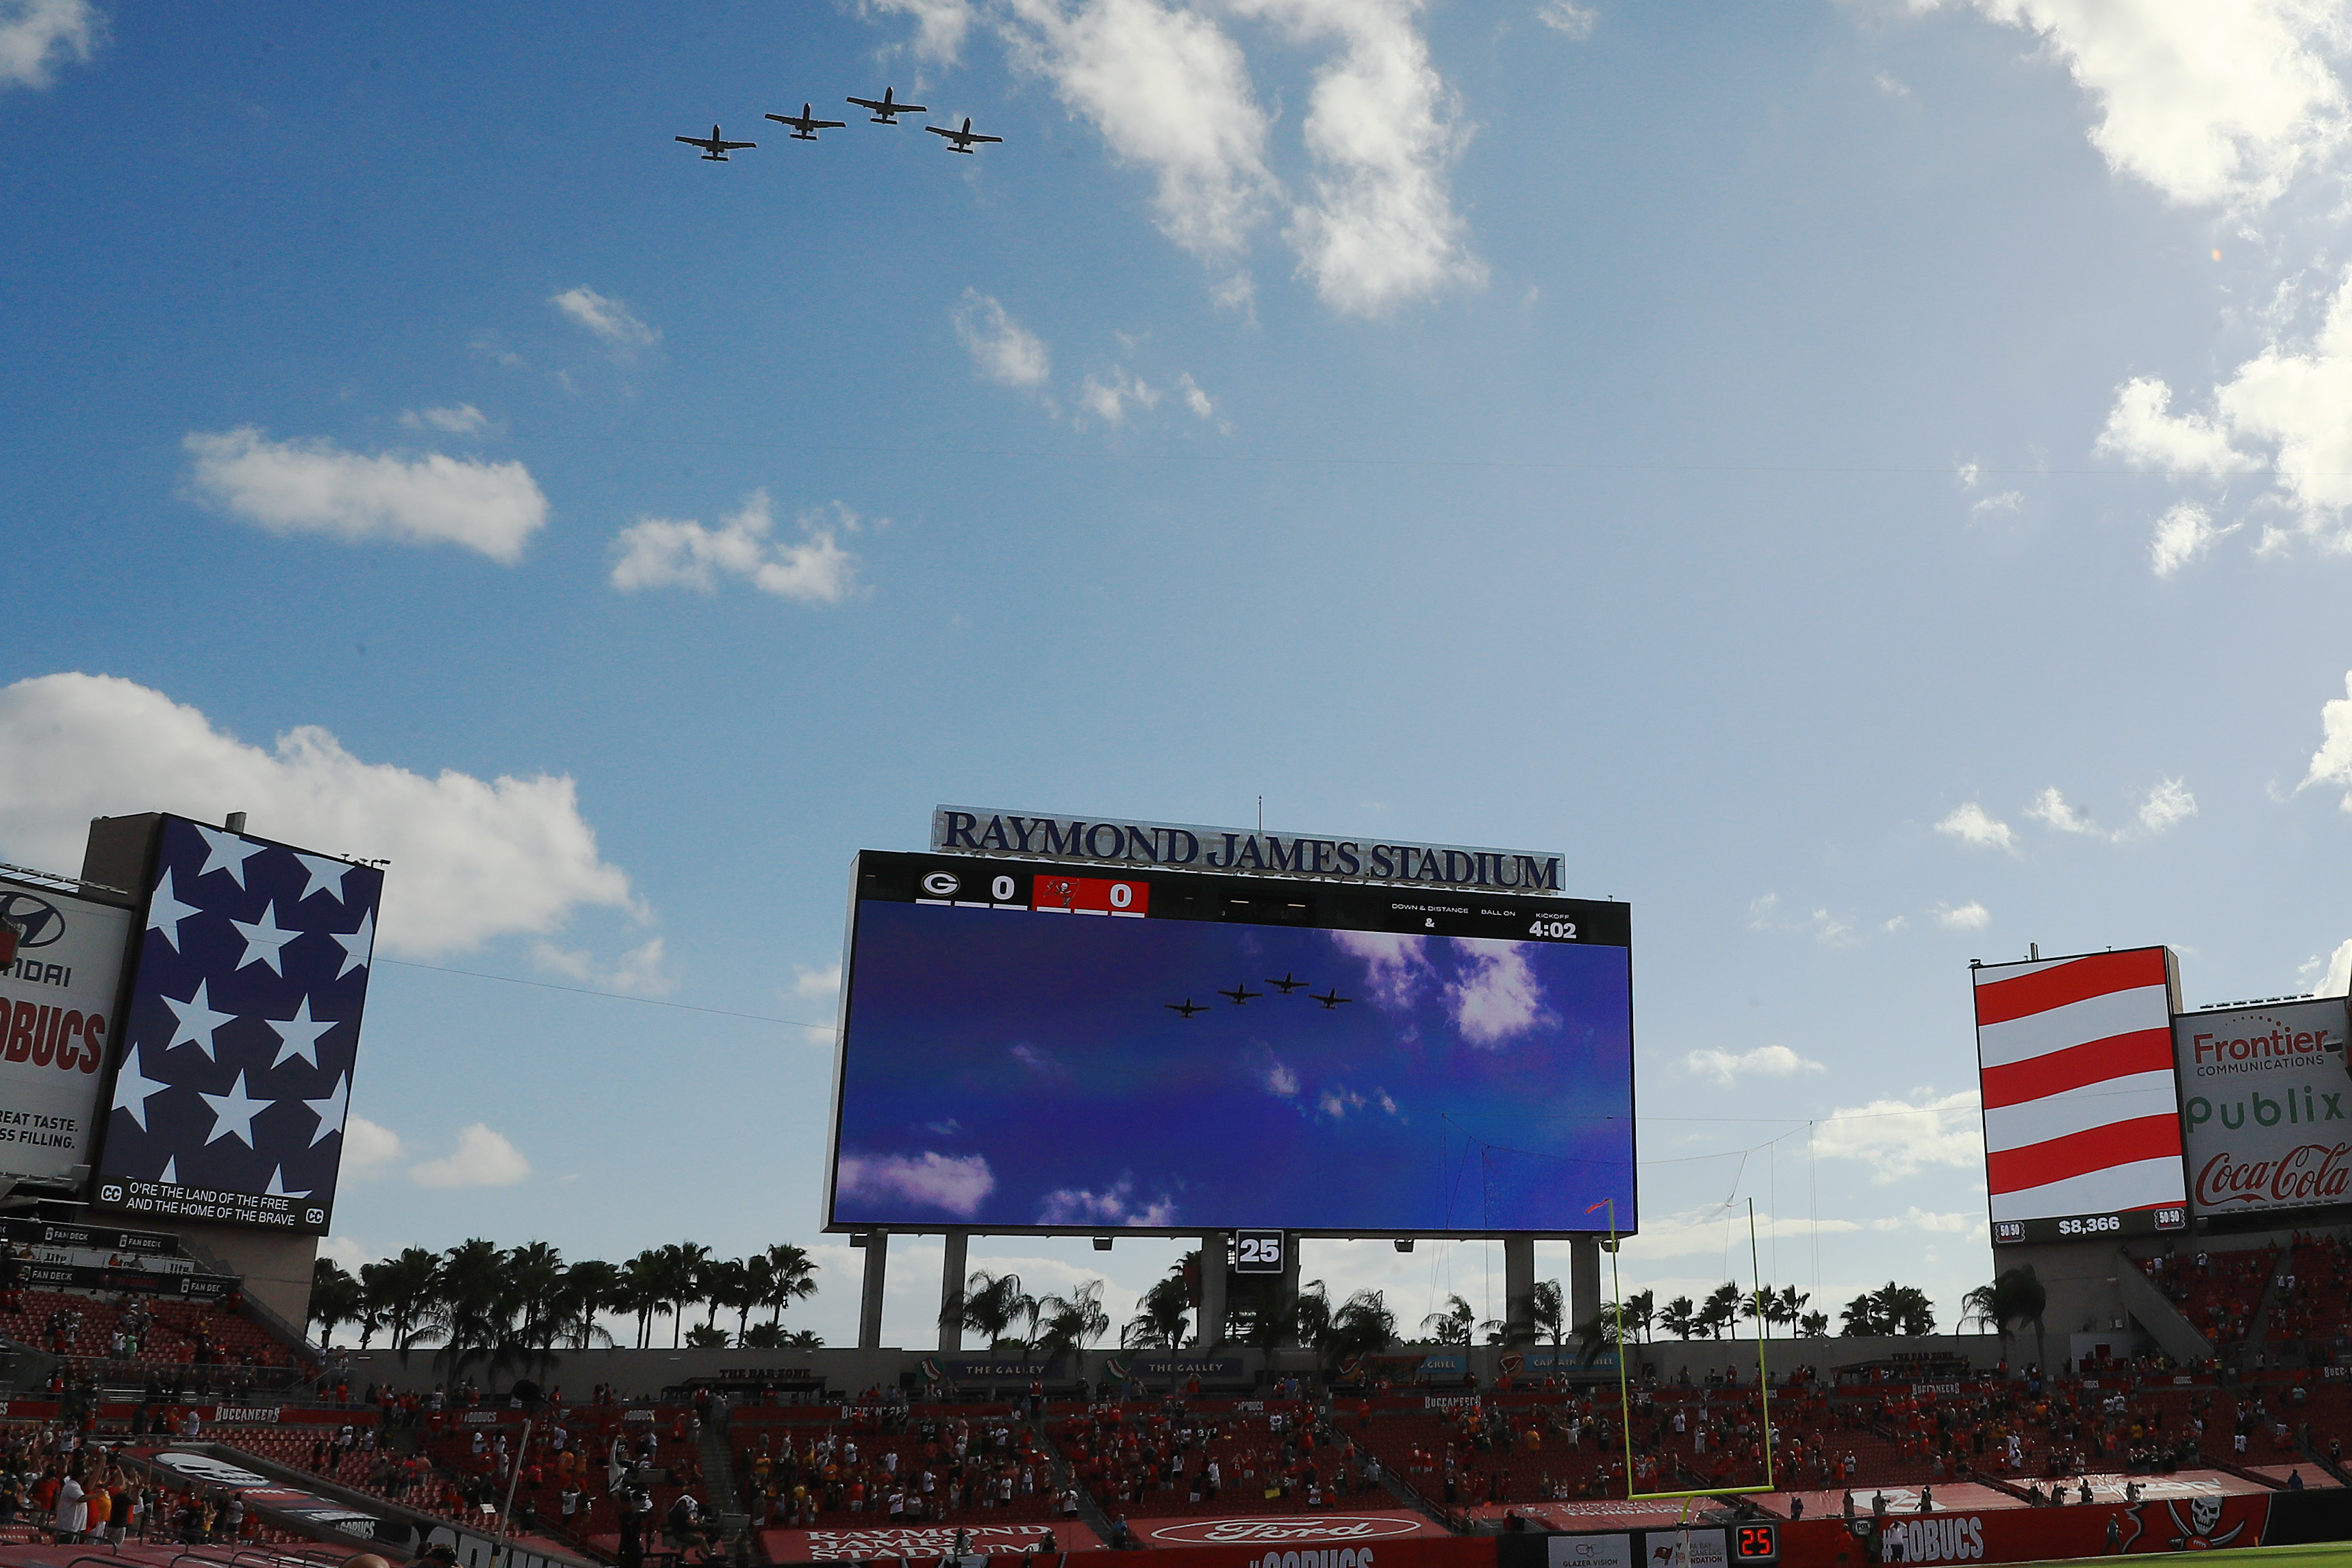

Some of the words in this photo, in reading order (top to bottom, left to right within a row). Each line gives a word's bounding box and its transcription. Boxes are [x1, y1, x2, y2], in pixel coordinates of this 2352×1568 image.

[943, 811, 1199, 863] RAYMOND
[1207, 833, 1360, 876] JAMES
[1370, 844, 1561, 891] STADIUM
[992, 876, 1015, 900] 0
[1109, 883, 1133, 908] 0
[1425, 918, 1435, 928] &
[1529, 921, 1577, 939] 4:02
[3, 957, 72, 987] NDAI
[2193, 1026, 2328, 1063] Frontier
[2197, 1055, 2324, 1076] COMMUNICATIONS
[34, 1115, 78, 1133] TASTE.
[0, 1129, 15, 1141] SS
[19, 1131, 75, 1149] FILLING.
[2195, 1142, 2352, 1206] Coca-Cola
[130, 1183, 157, 1197] O'RE
[161, 1185, 184, 1199] THE
[186, 1189, 216, 1203] LAND
[219, 1192, 234, 1205] OF
[237, 1194, 258, 1208] THE
[261, 1197, 289, 1211] FREE
[126, 1198, 153, 1211] AND
[155, 1200, 178, 1213] THE
[180, 1203, 214, 1217] HOME
[217, 1206, 233, 1219] OF
[235, 1209, 256, 1223] THE
[258, 1211, 296, 1226] BRAVE
[2059, 1216, 2120, 1235] $8,366
[70, 1232, 88, 1241] DECK
[128, 1238, 141, 1246] FAN
[1239, 1239, 1279, 1262] 25
[31, 1270, 49, 1279] FAN
[50, 1272, 73, 1281] DECK
[190, 1282, 205, 1291] FAN
[207, 1284, 222, 1293] DEC
[966, 1365, 991, 1374] THE
[1149, 1363, 1172, 1372] THE
[1178, 1363, 1224, 1372] GALLEY
[1427, 1361, 1456, 1369] GRILL
[2324, 1367, 2352, 1378] BUCC
[215, 1406, 281, 1423] BUCCANEERS
[806, 1526, 1051, 1541] RAYMOND
[1204, 1520, 1374, 1541] Ford
[1741, 1528, 1771, 1555] 25
[1691, 1556, 1723, 1564] NDATION
